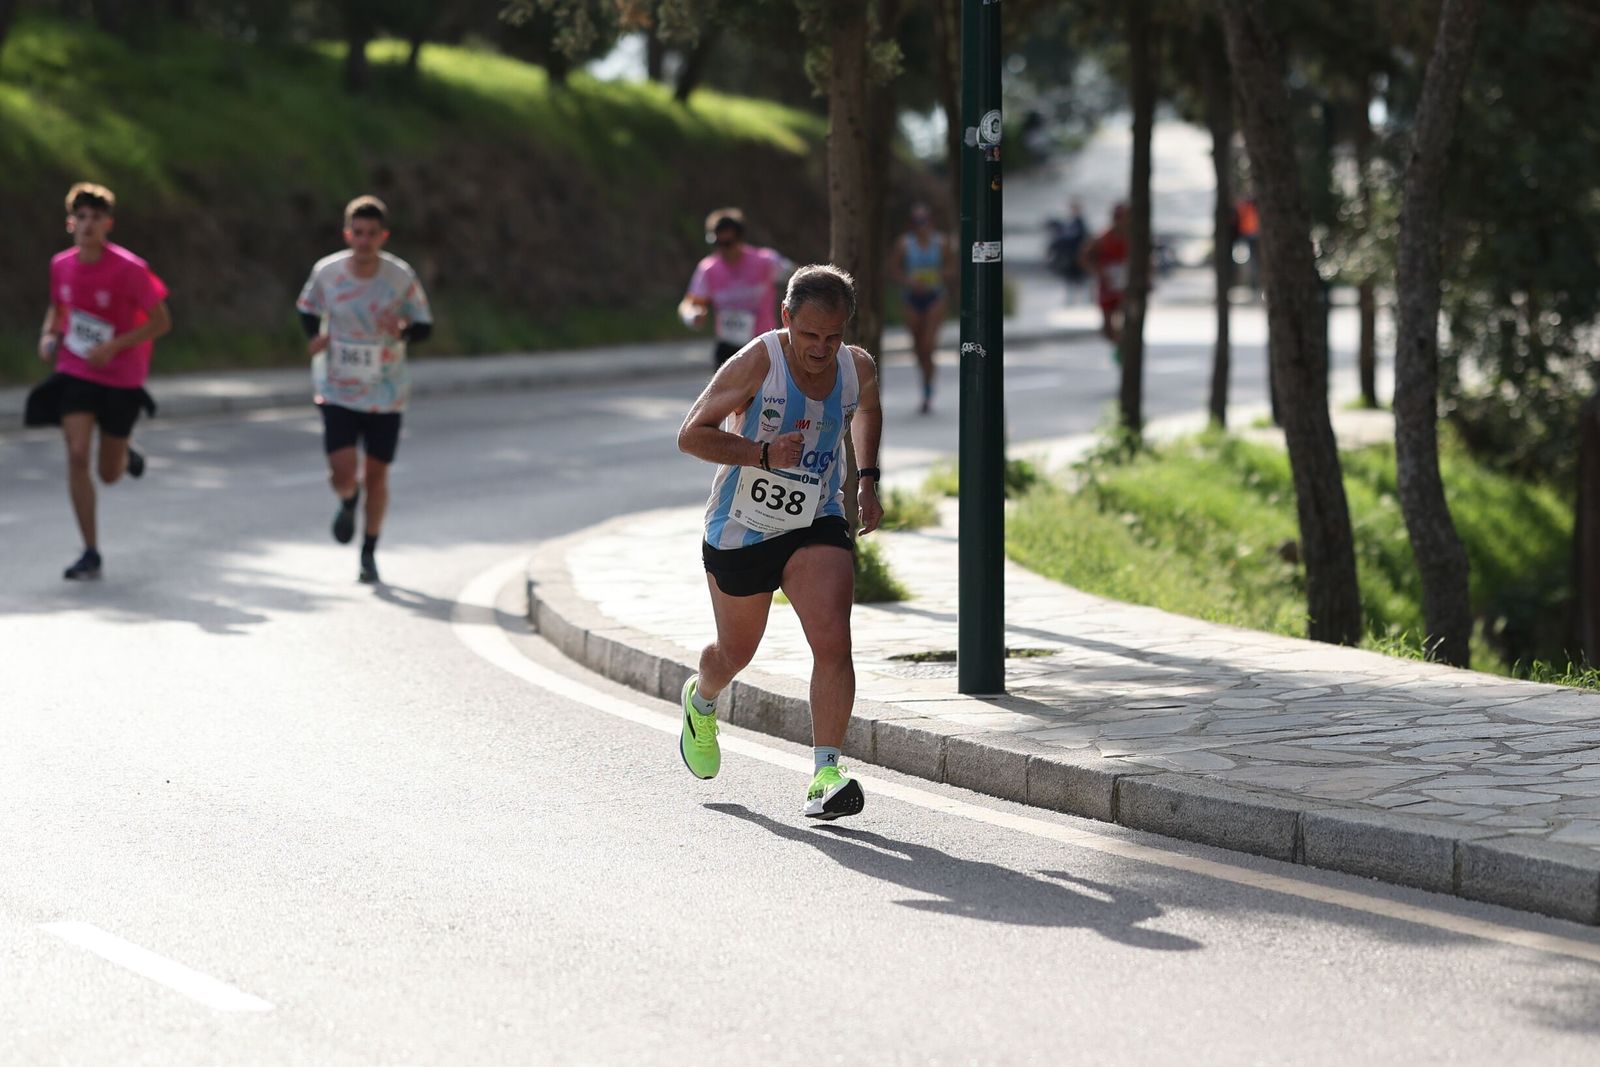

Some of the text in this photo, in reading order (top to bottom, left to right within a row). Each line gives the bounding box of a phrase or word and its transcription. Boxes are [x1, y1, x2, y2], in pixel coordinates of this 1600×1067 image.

[763, 396, 785, 405] vive
[797, 443, 834, 473] lag
[751, 478, 806, 515] 638
